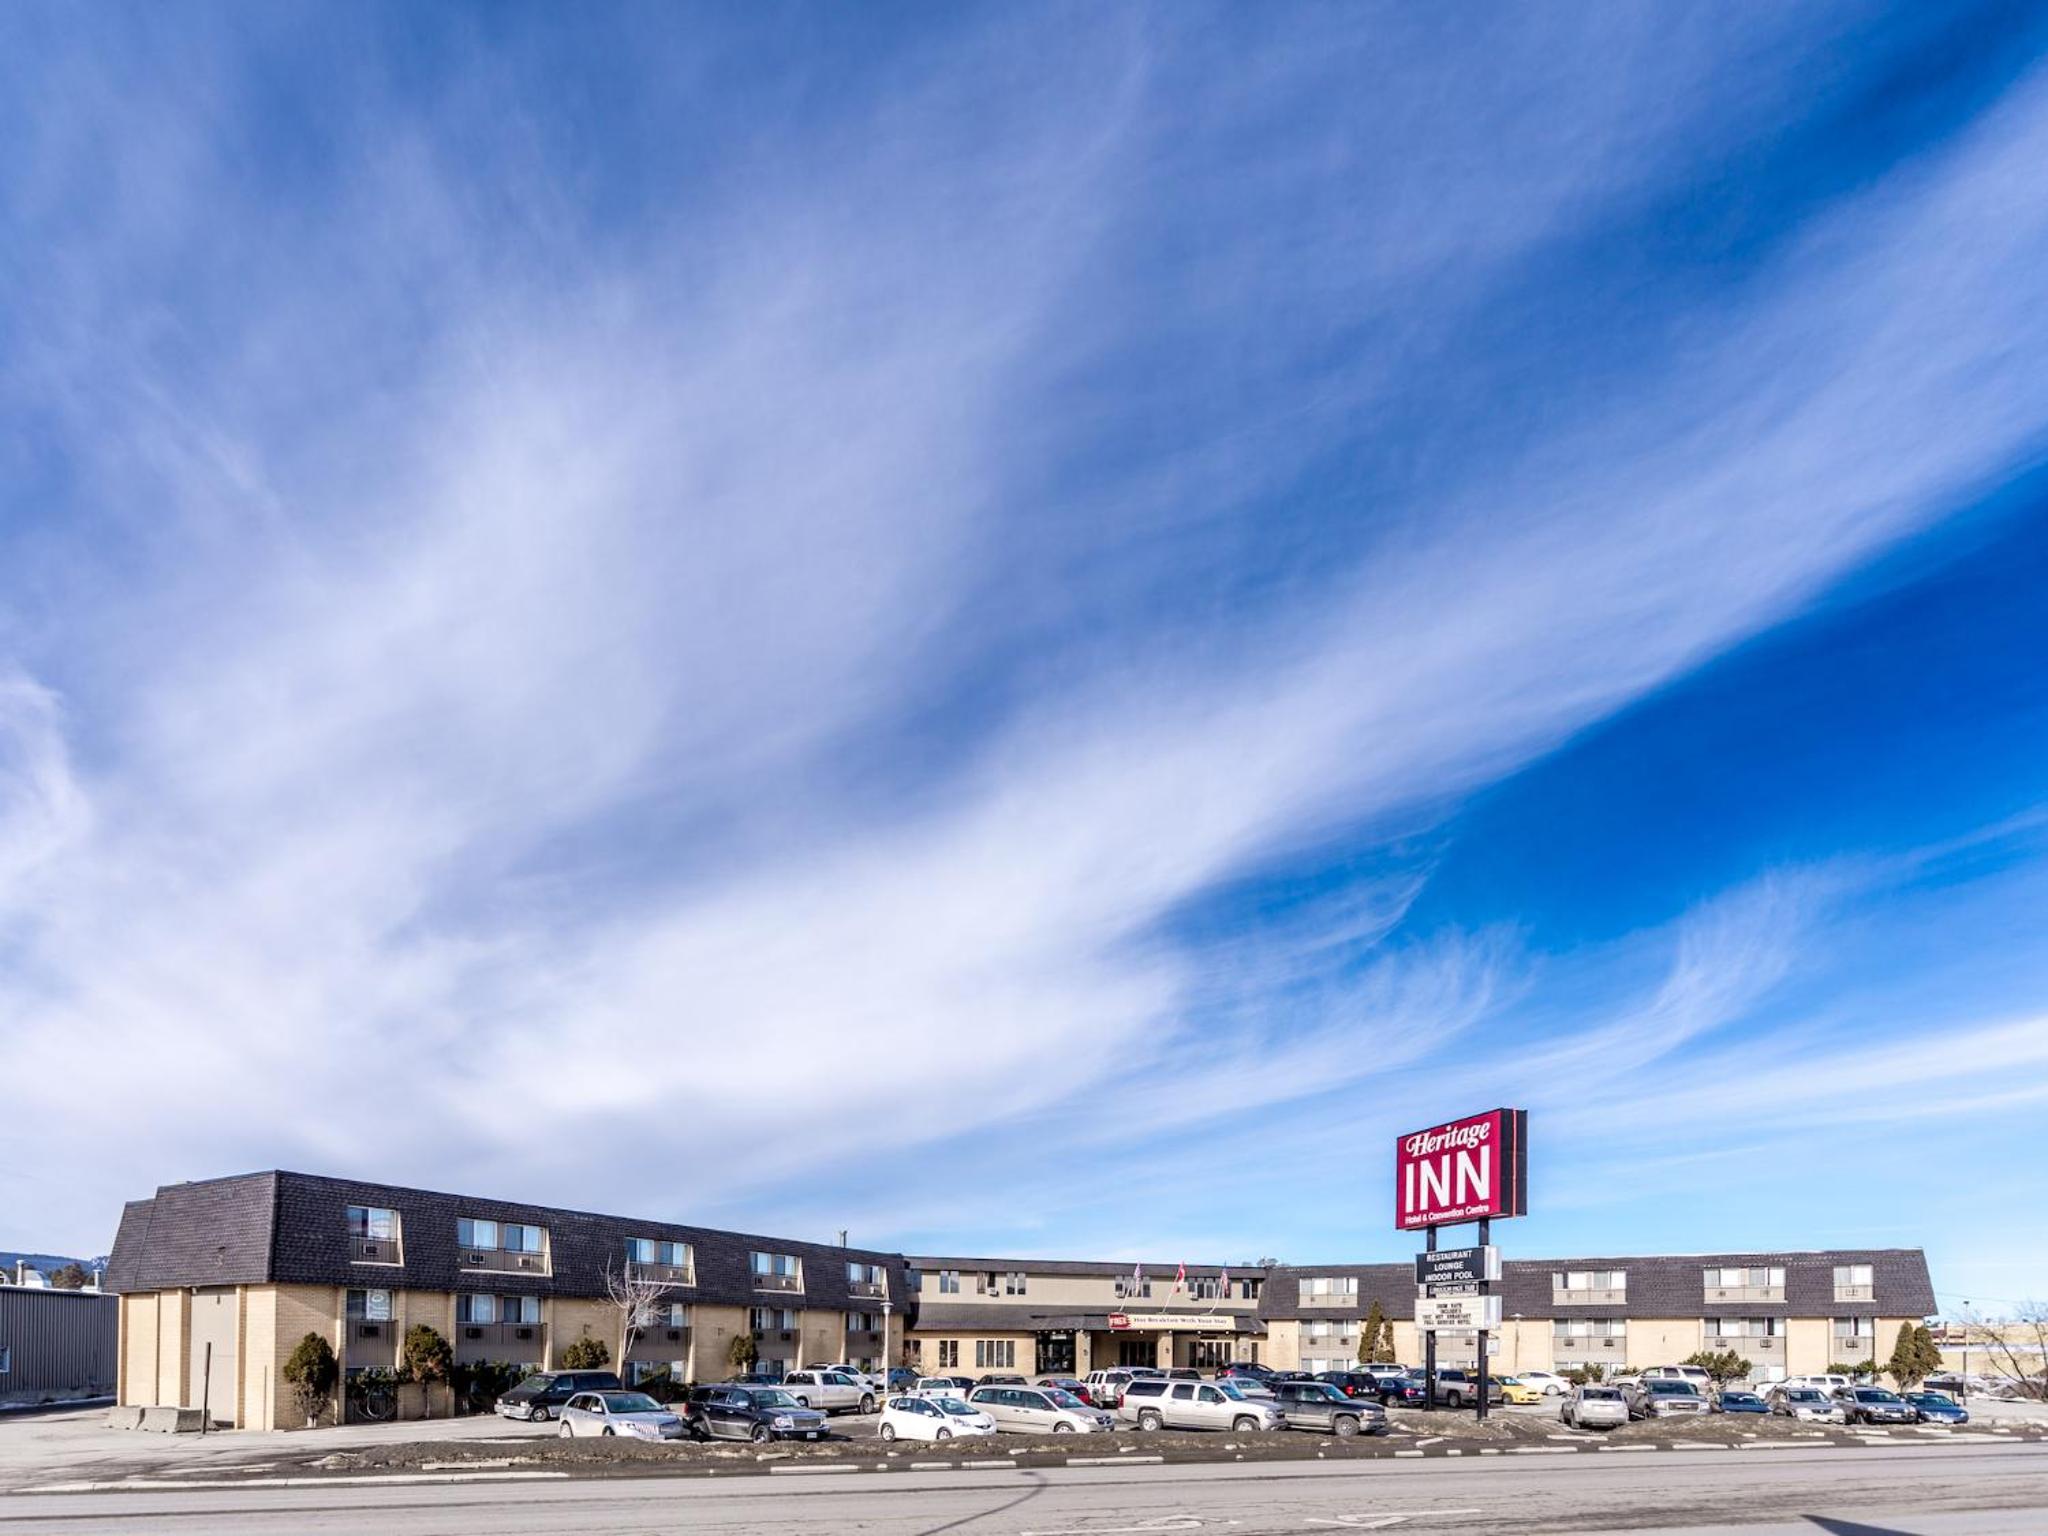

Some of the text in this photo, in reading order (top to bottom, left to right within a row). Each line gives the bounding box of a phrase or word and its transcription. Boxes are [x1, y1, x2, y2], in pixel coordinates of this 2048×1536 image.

[1406, 1121, 1491, 1157] Heritage
[1405, 1145, 1490, 1213] INN
[1405, 1214, 1421, 1224] Hotel
[1428, 1208, 1464, 1222] Convention
[1426, 1250, 1473, 1262] RESTAURANT
[1434, 1262, 1464, 1271] LOUNGE
[1425, 1271, 1474, 1281] INDOOR POOL
